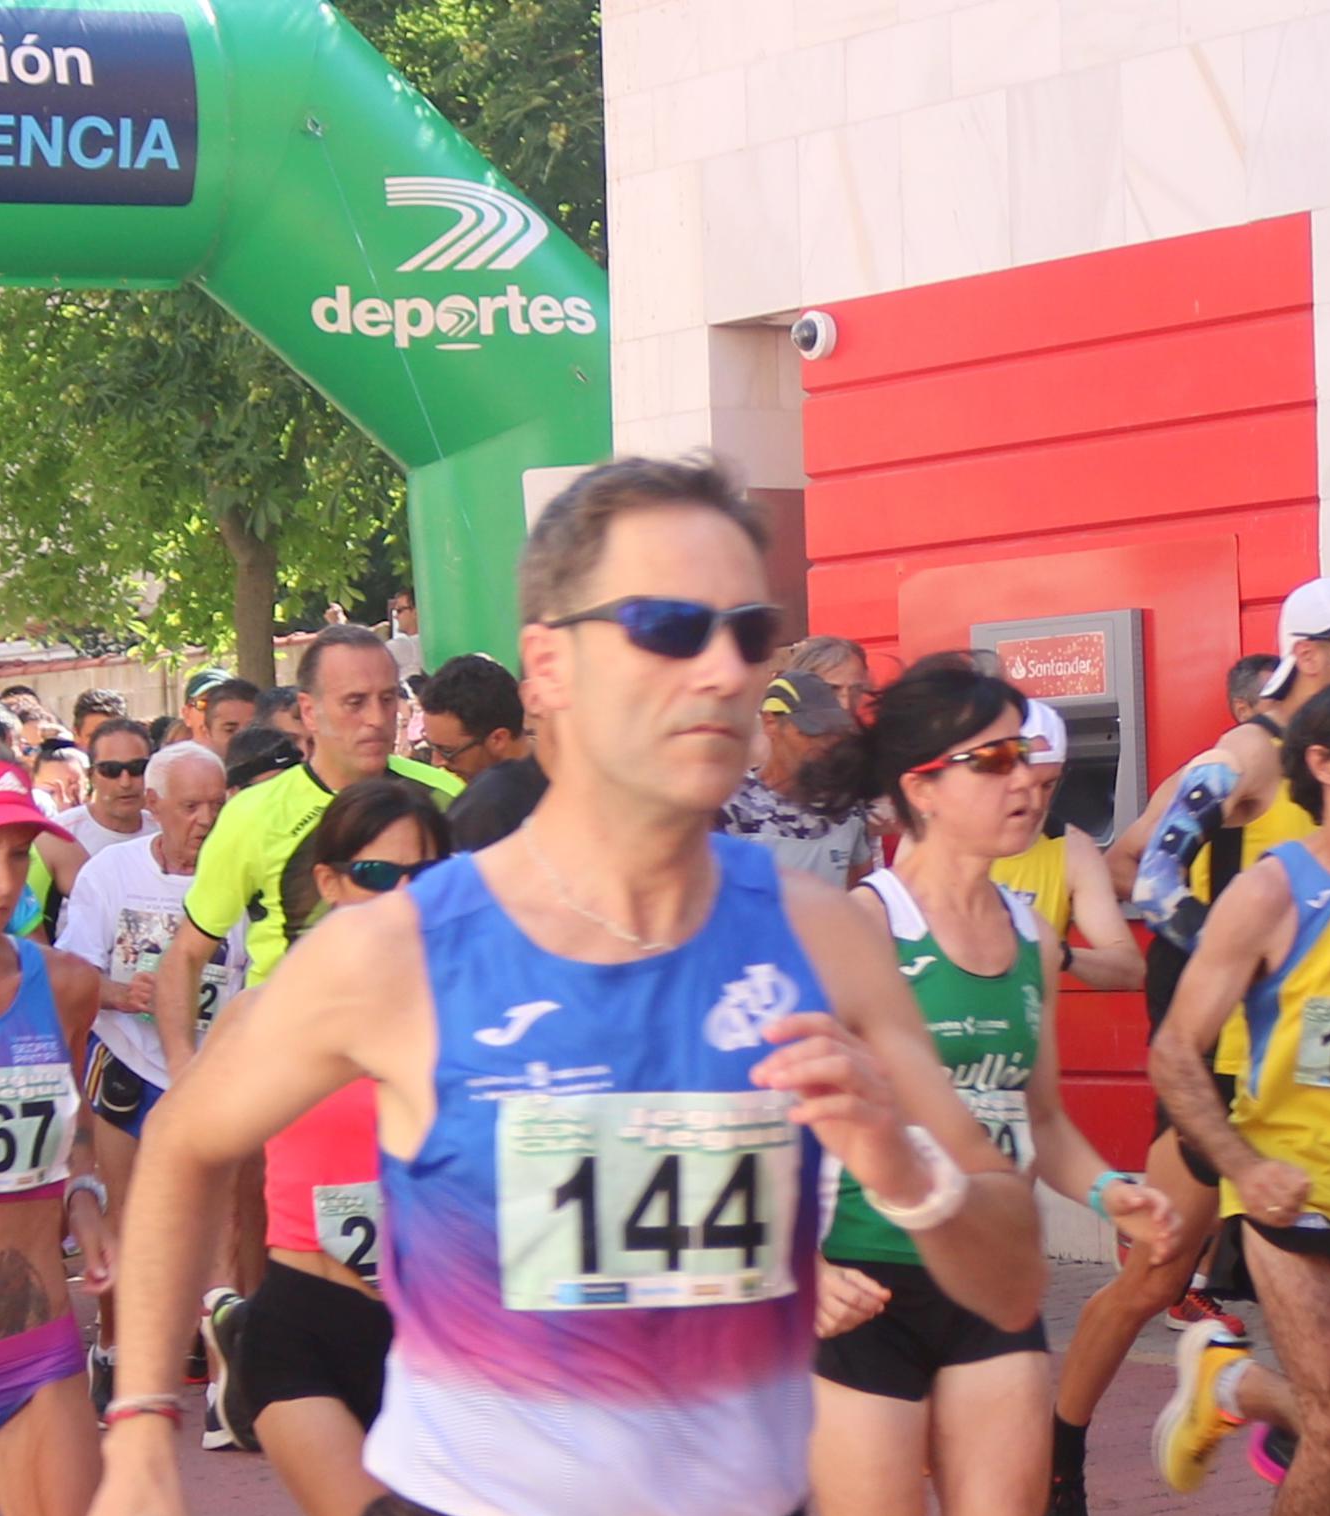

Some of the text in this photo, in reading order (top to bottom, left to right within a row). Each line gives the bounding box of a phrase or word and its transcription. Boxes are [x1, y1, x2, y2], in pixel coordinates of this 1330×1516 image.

[311, 285, 597, 348] deportes
[1027, 656, 1092, 678] Santander
[552, 1153, 767, 1275] 144
